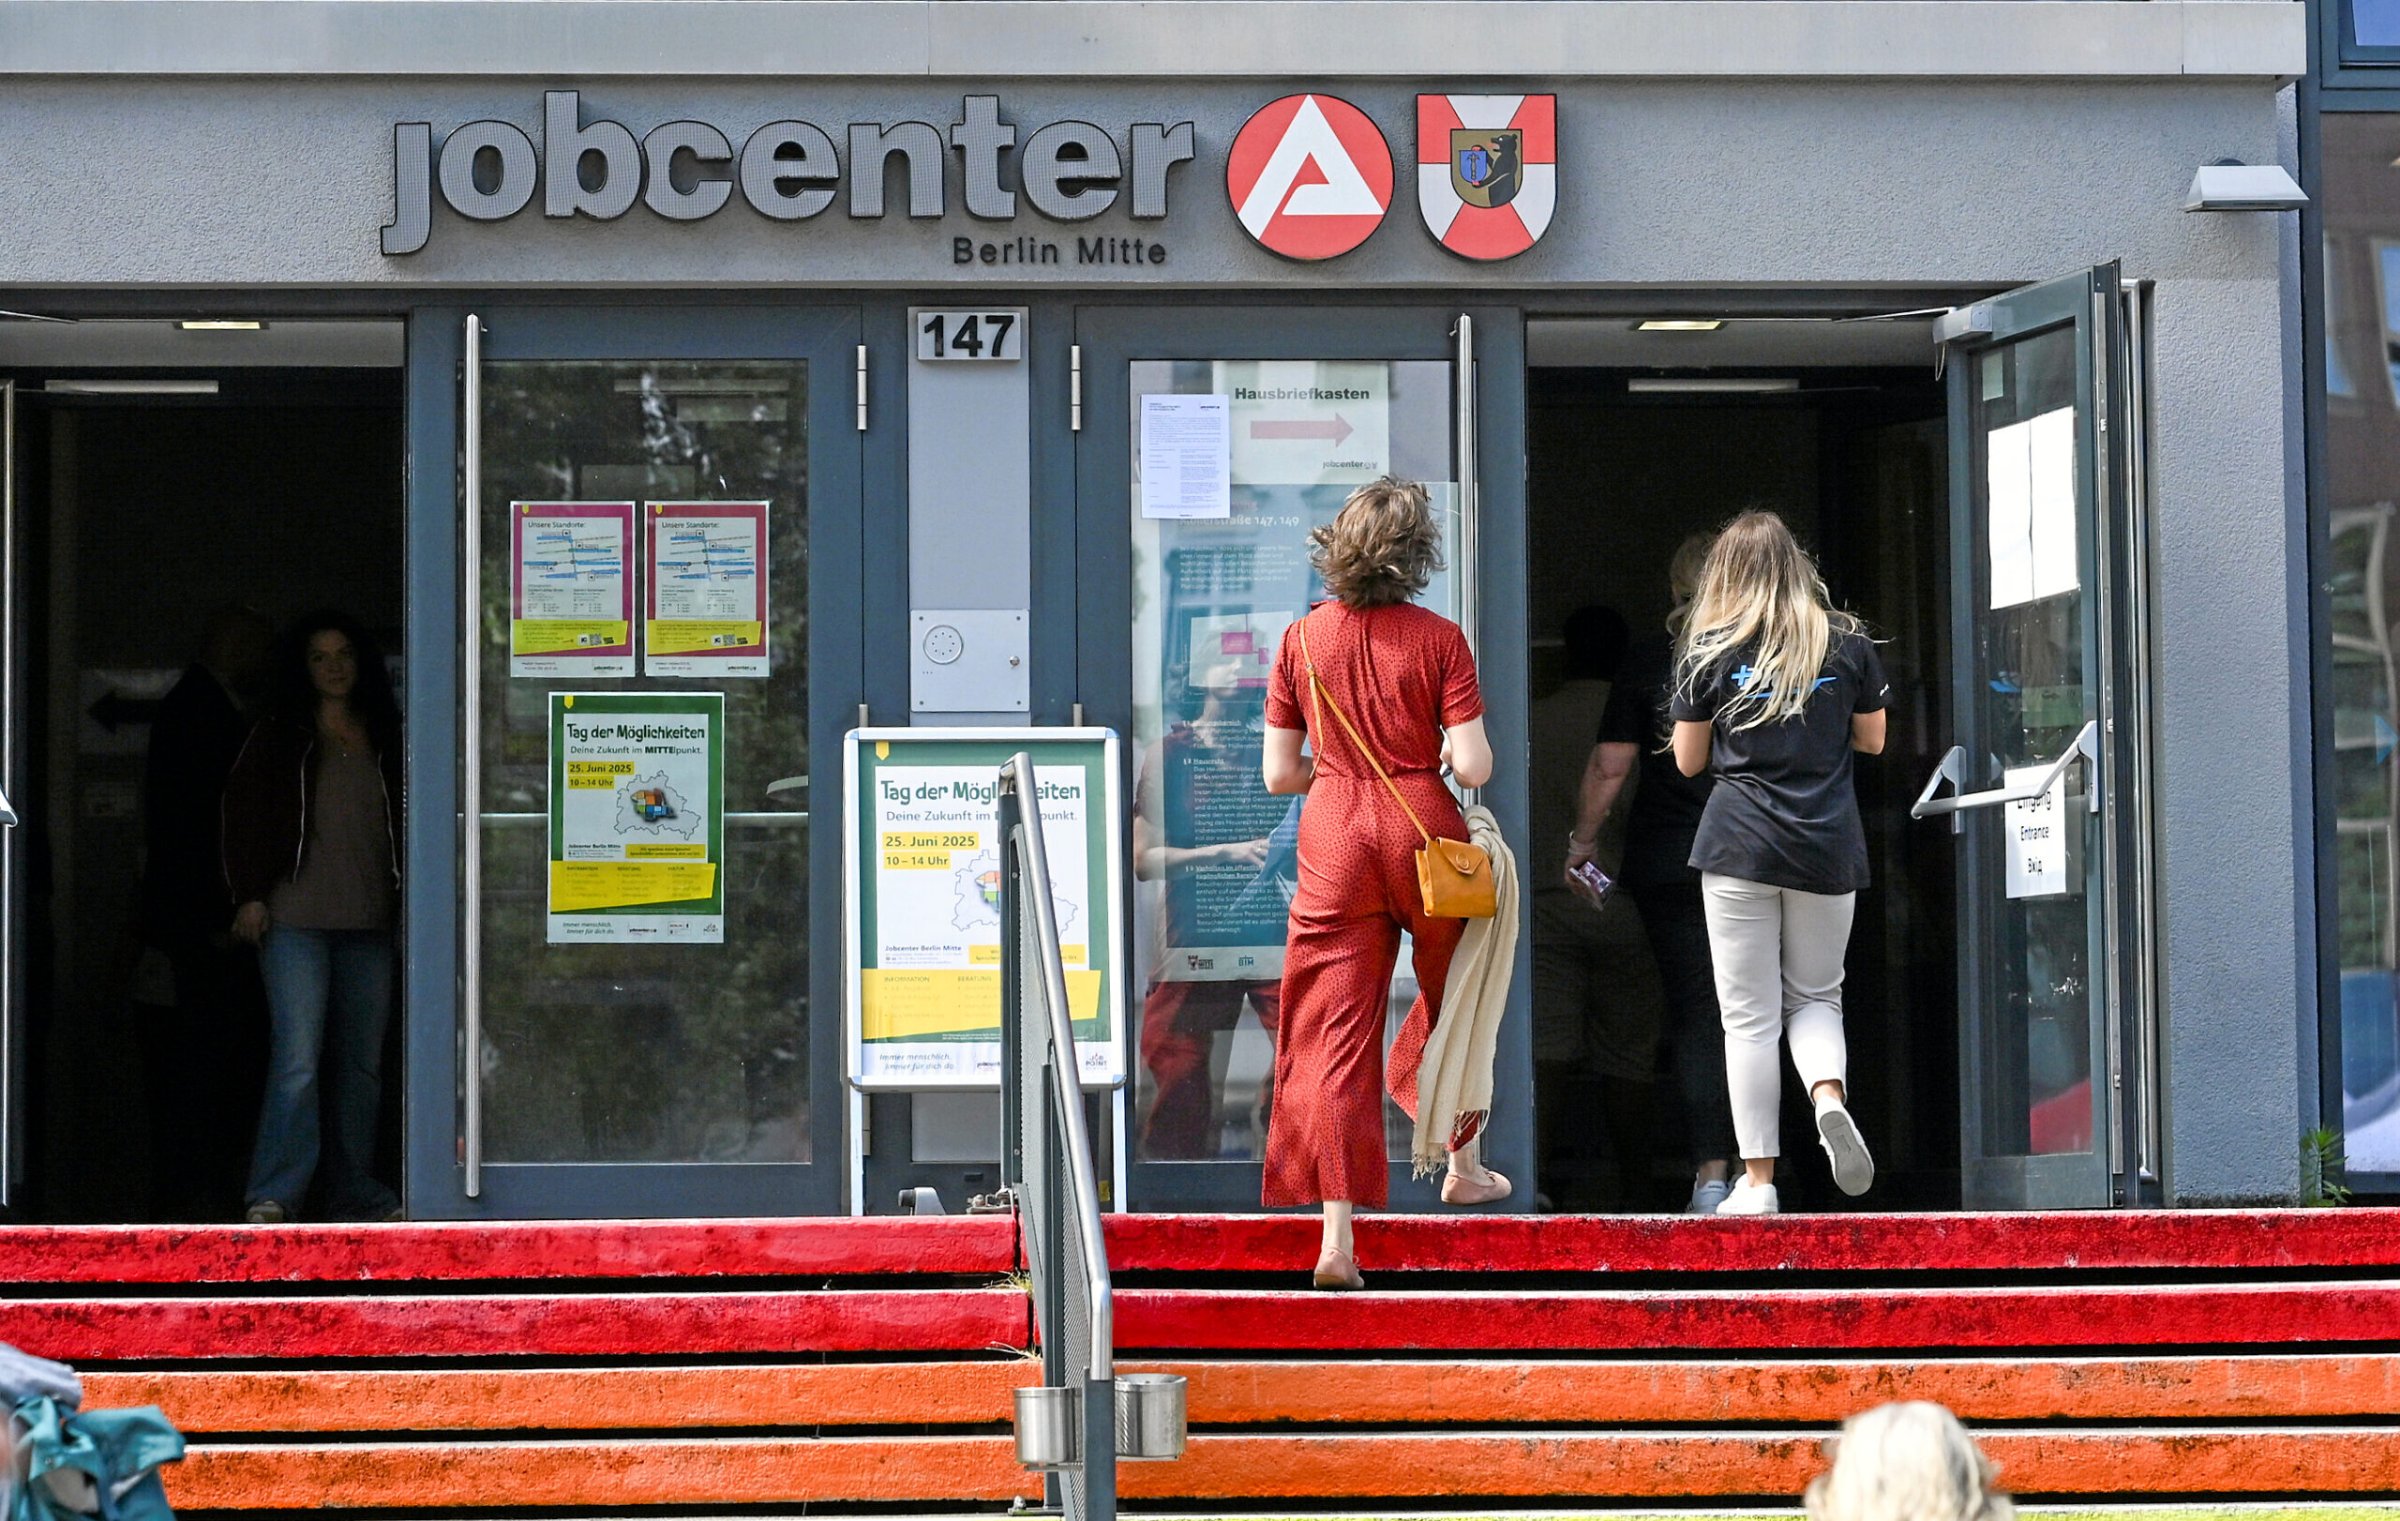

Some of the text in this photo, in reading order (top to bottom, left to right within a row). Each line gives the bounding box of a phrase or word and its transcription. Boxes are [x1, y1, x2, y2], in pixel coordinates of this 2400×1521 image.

[380, 90, 1194, 256] jobcenter
[953, 237, 1166, 265] Berlin Mitte
[922, 315, 1014, 357] 147
[1235, 387, 1370, 400] Hausbriefkasten
[1323, 460, 1363, 469] jobcenter
[662, 521, 684, 529] Unsere
[1280, 515, 1300, 527] 149
[567, 724, 705, 742] Tag der Möglichkeiten
[570, 746, 702, 755] Deine Zukunft im MITTElpunkt.
[570, 764, 631, 773] 25. Juni 2025
[570, 779, 580, 787] 10
[587, 779, 596, 787] 14
[598, 779, 613, 787] Uhr
[881, 780, 1081, 805] Tag der Mögleiten
[886, 811, 921, 821] Deine
[924, 811, 972, 821] Zukunft
[976, 811, 990, 821] im
[2020, 825, 2050, 841] Entrance
[885, 835, 975, 848] 25. Juni 2025
[886, 856, 900, 866] 10
[911, 856, 924, 866] 14
[928, 856, 948, 866] Uhr
